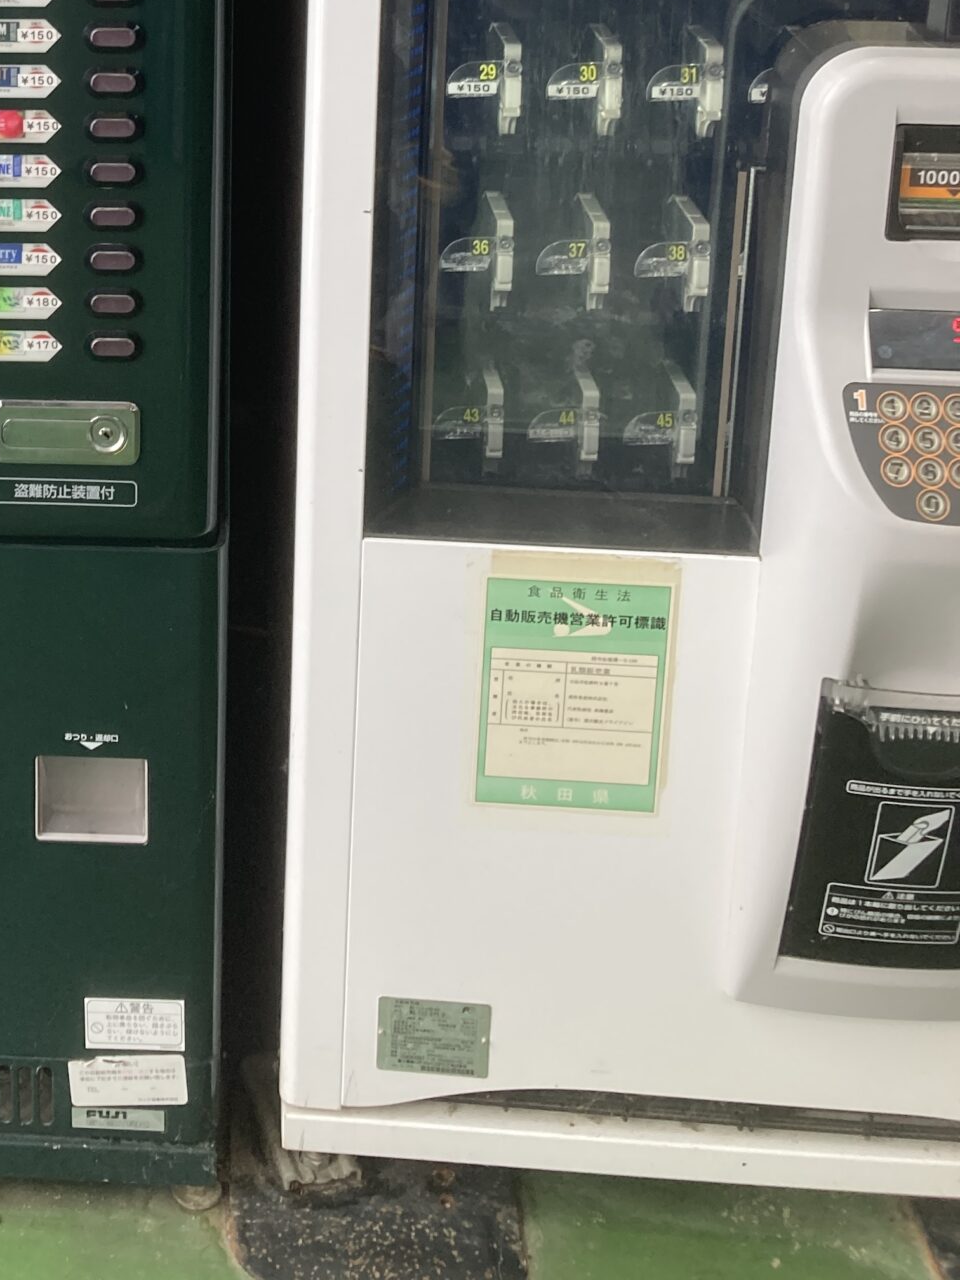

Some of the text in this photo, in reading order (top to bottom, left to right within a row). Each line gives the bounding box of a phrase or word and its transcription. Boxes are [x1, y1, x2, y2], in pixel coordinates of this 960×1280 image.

[21, 31, 53, 41] ¥150
[479, 63, 497, 80] 29
[580, 65, 597, 82] 30
[681, 67, 697, 84] 31
[21, 76, 54, 86] ¥150
[456, 83, 490, 93] ¥150
[556, 86, 590, 96] ¥150
[659, 87, 693, 97] ¥150
[27, 121, 59, 131] ¥150
[25, 166, 57, 176] ¥150
[26, 211, 57, 220] ¥150
[472, 239, 489, 256] 36
[569, 242, 585, 258] 37
[668, 245, 685, 261] 38
[25, 254, 57, 264] ¥150
[26, 297, 58, 307] ¥180
[27, 340, 59, 350] ¥170
[853, 389, 867, 411] 1
[463, 409, 479, 422] 43
[559, 411, 575, 425] 44
[656, 413, 673, 428] 45
[14, 483, 115, 501] 盗難防止装置付
[528, 584, 631, 602] 食品衛生法
[490, 608, 667, 631] 自動販売機営業許可標識
[520, 784, 610, 805] 秋田県
[130, 1001, 154, 1014] 警告
[86, 1109, 127, 1119] FUJI
